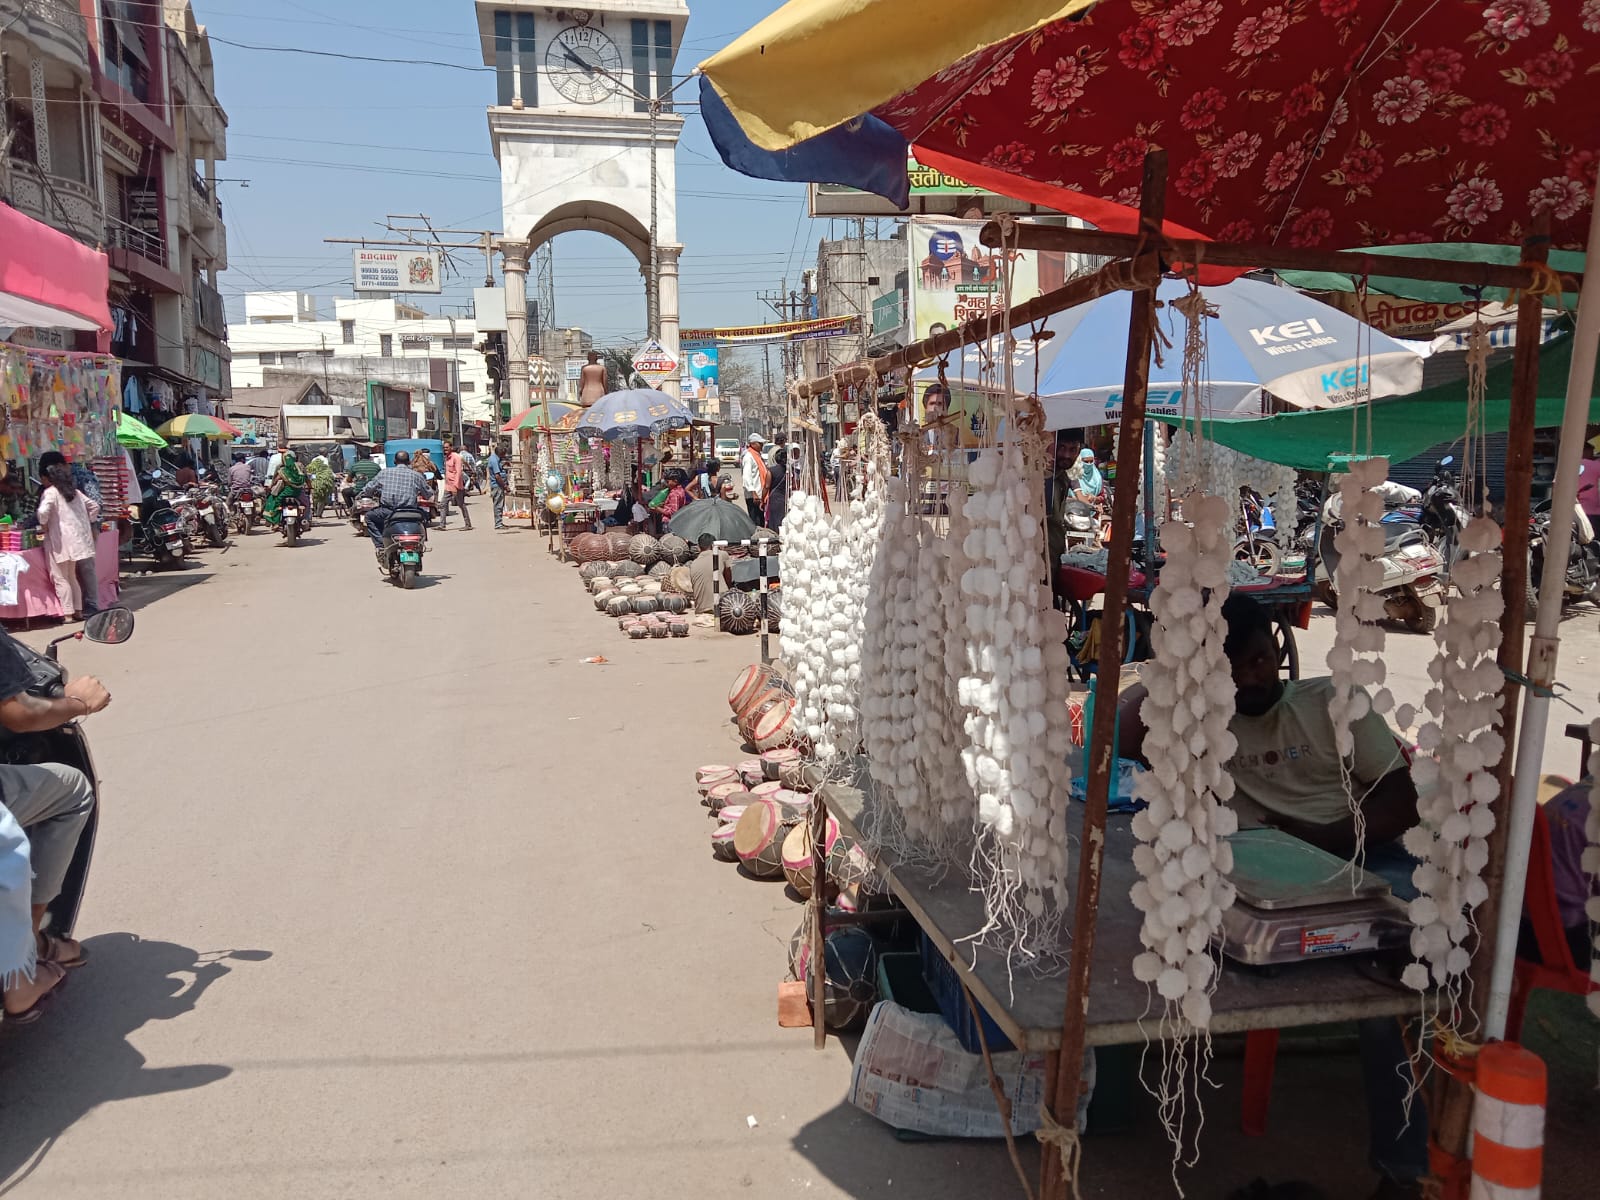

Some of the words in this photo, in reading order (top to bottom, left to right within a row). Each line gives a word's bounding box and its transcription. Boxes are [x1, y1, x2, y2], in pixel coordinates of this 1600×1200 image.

[565, 34, 574, 45] 11
[579, 31, 589, 42] 12
[907, 165, 941, 188] संती
[1248, 318, 1326, 346] KEI
[1263, 344, 1296, 357] Wires
[1301, 336, 1339, 348] Cables
[636, 361, 662, 371] GOAL
[1320, 363, 1368, 393] KEI
[1145, 407, 1178, 416] ables
